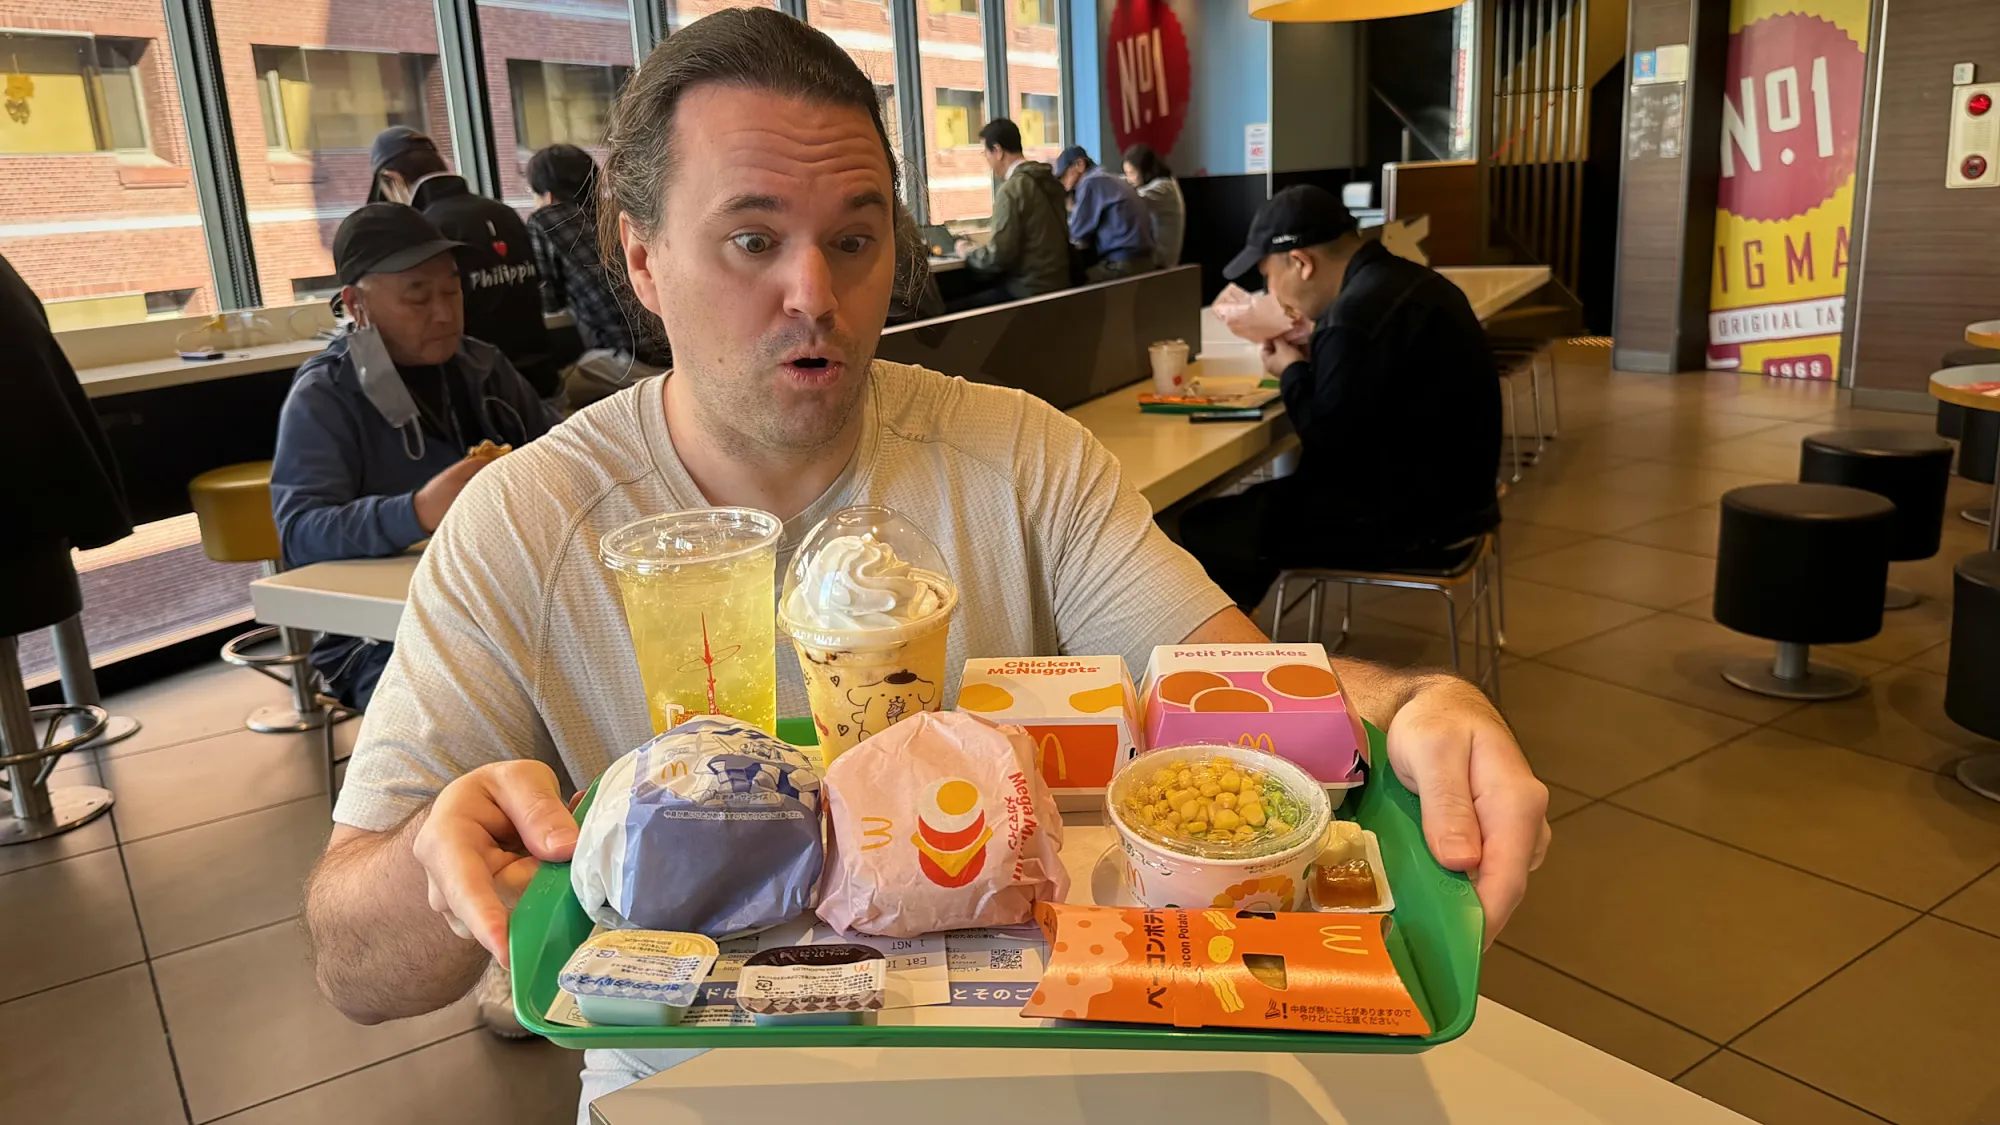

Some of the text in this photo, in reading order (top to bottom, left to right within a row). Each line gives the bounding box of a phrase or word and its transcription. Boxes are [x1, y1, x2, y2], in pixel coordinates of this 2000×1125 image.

[1173, 648, 1309, 659] Petit Pancakes
[1004, 660, 1081, 668] Chicken
[1008, 772, 1035, 815] Mega
[1004, 796, 1020, 850] メガマフィン
[1177, 914, 1190, 940] Potato
[890, 940, 912, 950] NGT
[905, 956, 927, 966] Eat
[953, 988, 1032, 1000] とそのご
[1290, 1004, 1412, 1017] 中身が熱いことがありますので
[1300, 1013, 1400, 1026] やけどにご注意ください。
